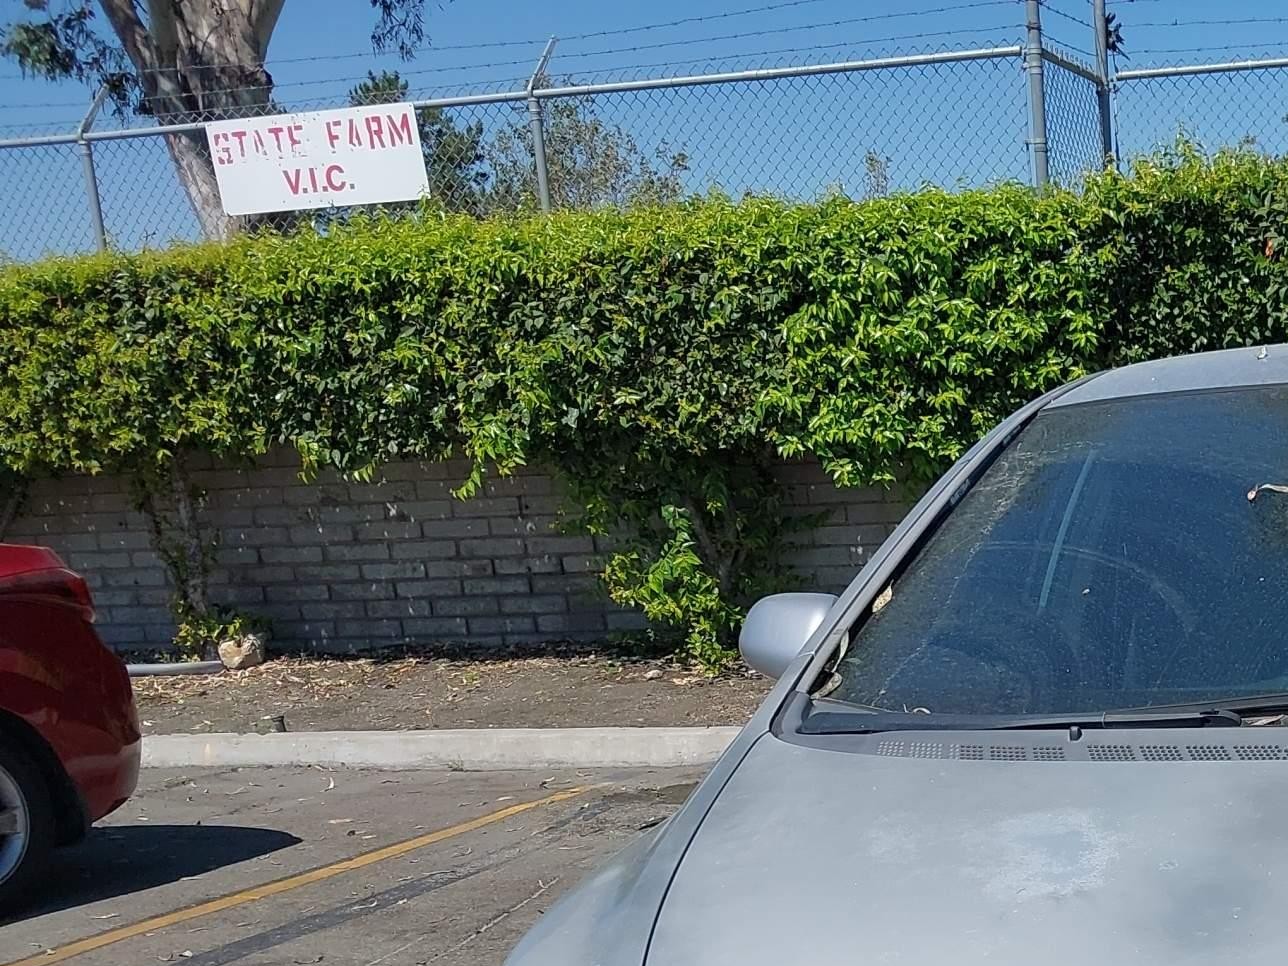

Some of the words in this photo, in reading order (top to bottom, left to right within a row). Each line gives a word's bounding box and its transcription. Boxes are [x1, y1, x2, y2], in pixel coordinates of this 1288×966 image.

[213, 125, 307, 165] STATE
[325, 113, 414, 153] FARM
[282, 165, 356, 195] V.I.C.
